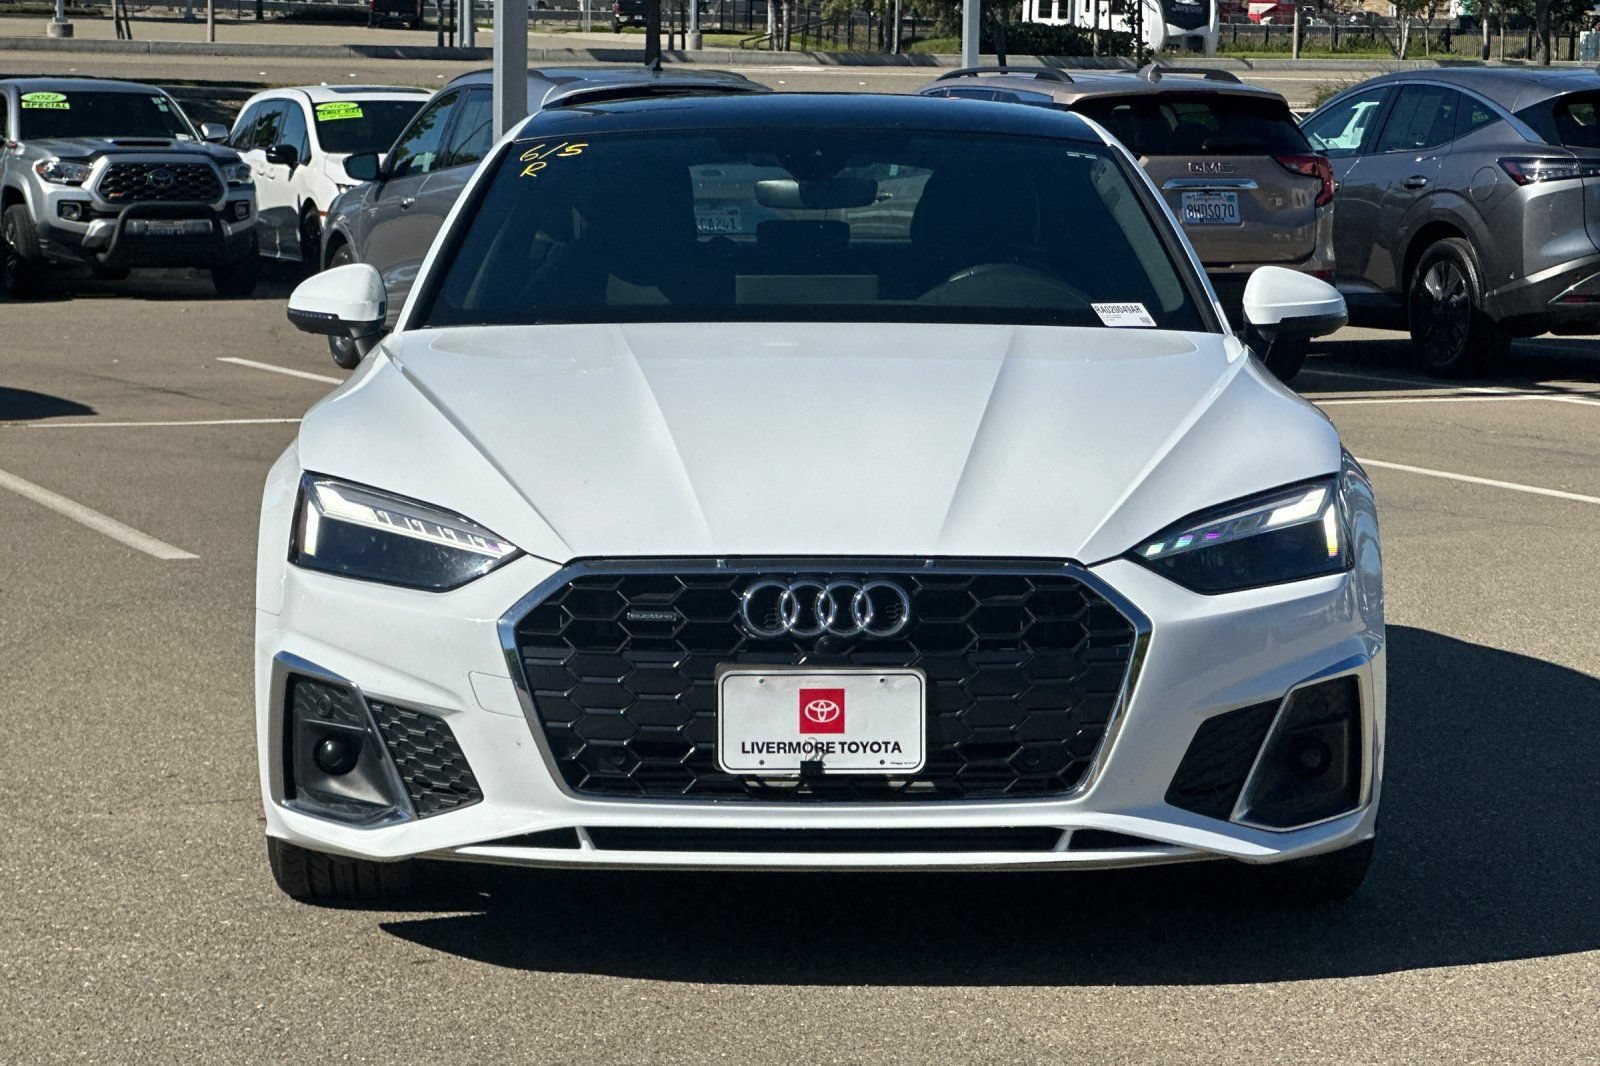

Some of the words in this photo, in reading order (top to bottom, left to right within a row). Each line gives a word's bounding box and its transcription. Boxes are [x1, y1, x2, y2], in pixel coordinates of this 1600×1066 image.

[520, 161, 547, 177] R
[1188, 162, 1234, 173] GMC
[741, 741, 836, 754] LIVERMORE
[838, 741, 903, 754] TOYOTA
